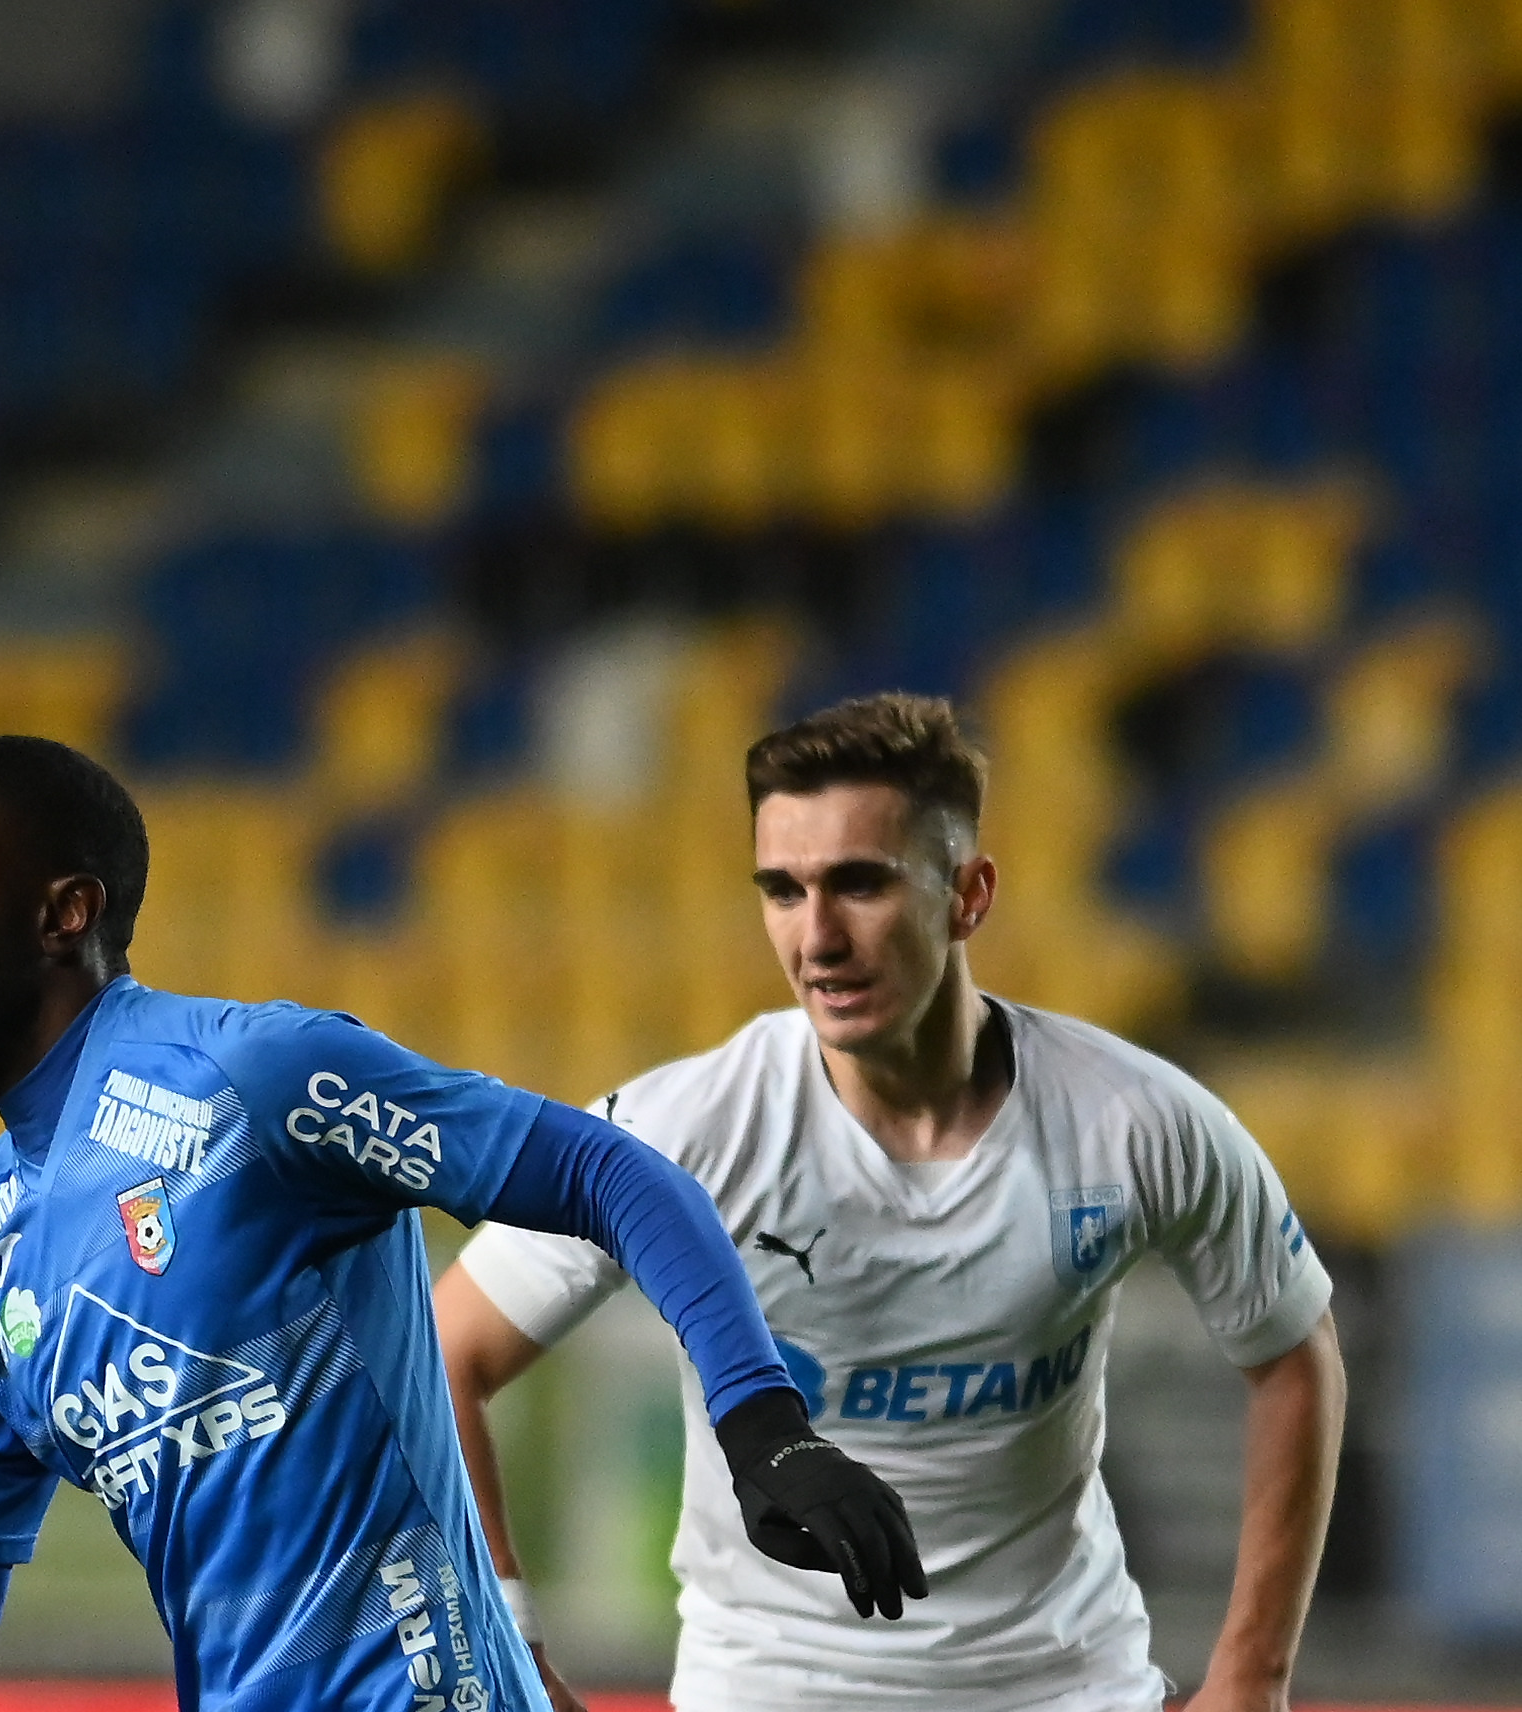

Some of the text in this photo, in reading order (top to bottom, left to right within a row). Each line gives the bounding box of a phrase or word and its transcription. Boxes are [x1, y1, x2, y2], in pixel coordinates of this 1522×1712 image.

[89, 1094, 210, 1176] TARGOVISTE
[285, 1107, 432, 1191] CARS
[306, 1071, 443, 1164] CATA
[840, 1325, 1092, 1422] BETANO
[160, 1383, 287, 1468] XPS
[438, 1563, 475, 1671] HEXMAN
